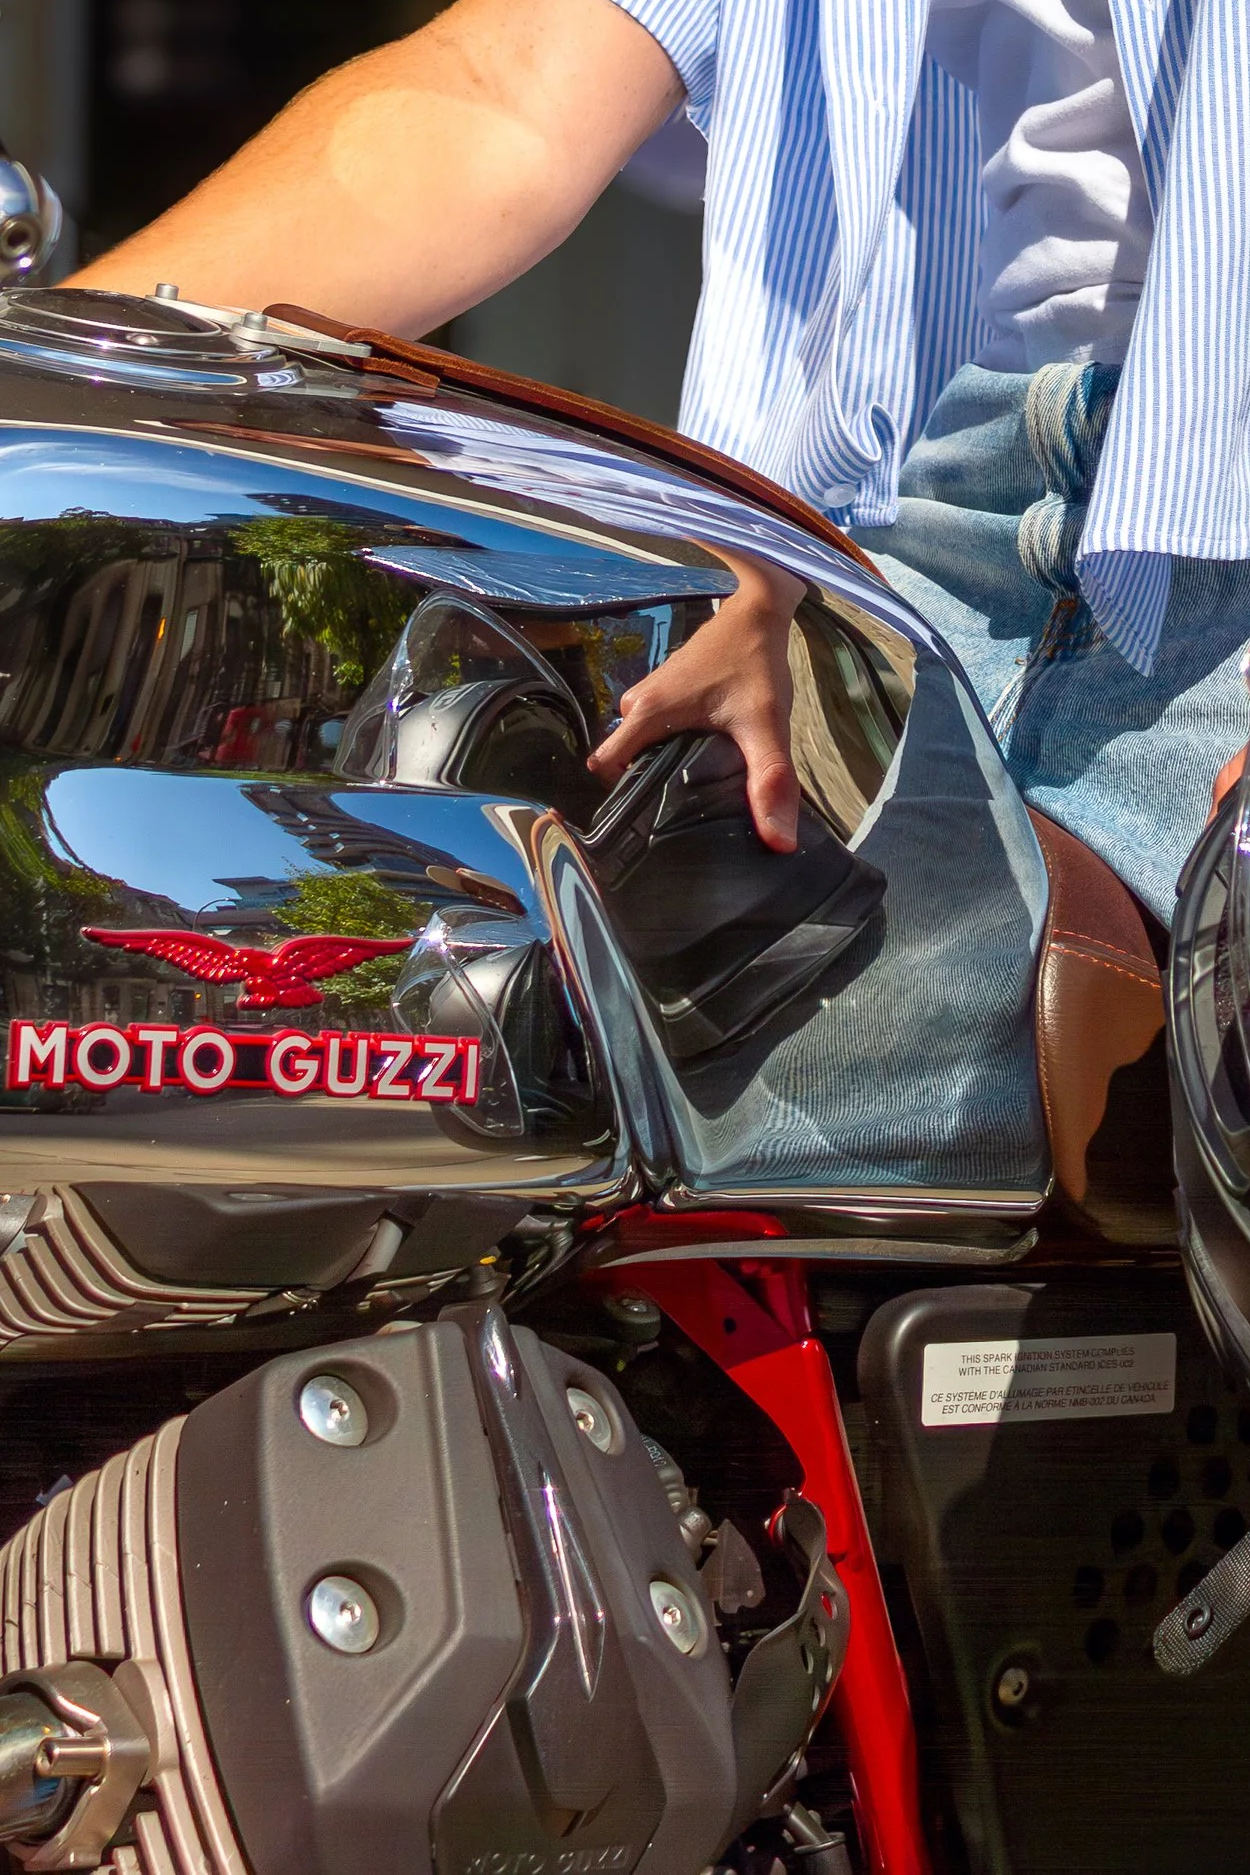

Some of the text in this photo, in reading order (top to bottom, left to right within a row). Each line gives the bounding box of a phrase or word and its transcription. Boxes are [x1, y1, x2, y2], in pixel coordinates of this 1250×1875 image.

[10, 1021, 481, 1103] MOTO GUZZI
[961, 1355, 981, 1363] THIS
[983, 1353, 1012, 1363] SPARK
[1015, 1351, 1052, 1361] IGNITION
[1054, 1349, 1090, 1359] SYSTEM
[958, 1367, 981, 1377] WITH
[984, 1366, 1000, 1375] THE
[1002, 1363, 1047, 1375] CANADIAN
[1049, 1361, 1095, 1371] STANDARD
[930, 1393, 944, 1403] CE
[1046, 1387, 1064, 1397] PAR
[1114, 1383, 1126, 1393] DE
[942, 1405, 960, 1415] EST
[961, 1402, 1011, 1414] CONFORME
[1022, 1401, 1033, 1411] LA
[1034, 1398, 1069, 1409] NORME
[1106, 1395, 1120, 1405] DU
[1121, 1394, 1156, 1405] CANADA
